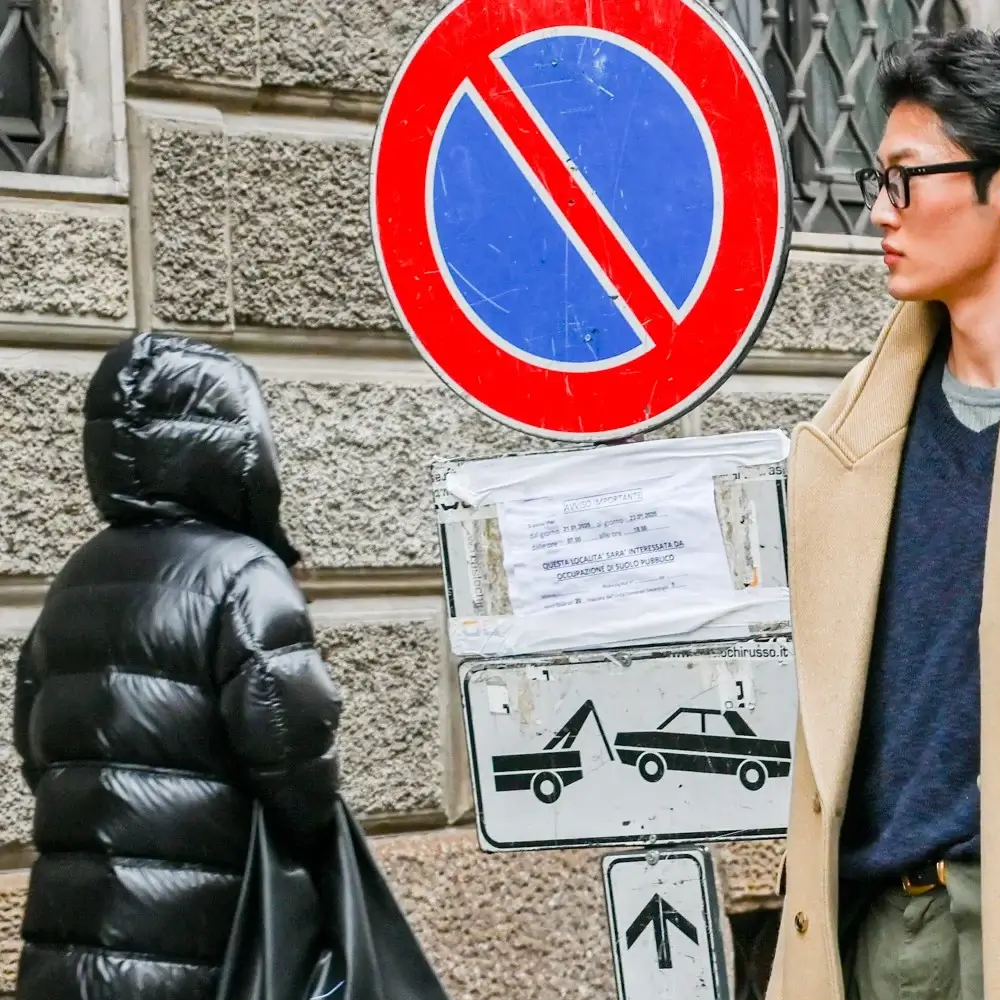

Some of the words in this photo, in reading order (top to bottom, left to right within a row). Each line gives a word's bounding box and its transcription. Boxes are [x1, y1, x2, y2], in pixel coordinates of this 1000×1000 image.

[564, 500, 592, 513] AVVISO
[595, 491, 643, 505] IMPORTANTE
[542, 559, 570, 571] QUESTA
[628, 541, 672, 556] INTERESSATA
[556, 565, 605, 581] OCCUPAZIONE
[606, 563, 615, 572] DI
[615, 559, 639, 571] SUOLO
[640, 554, 675, 567] PUBBLICO
